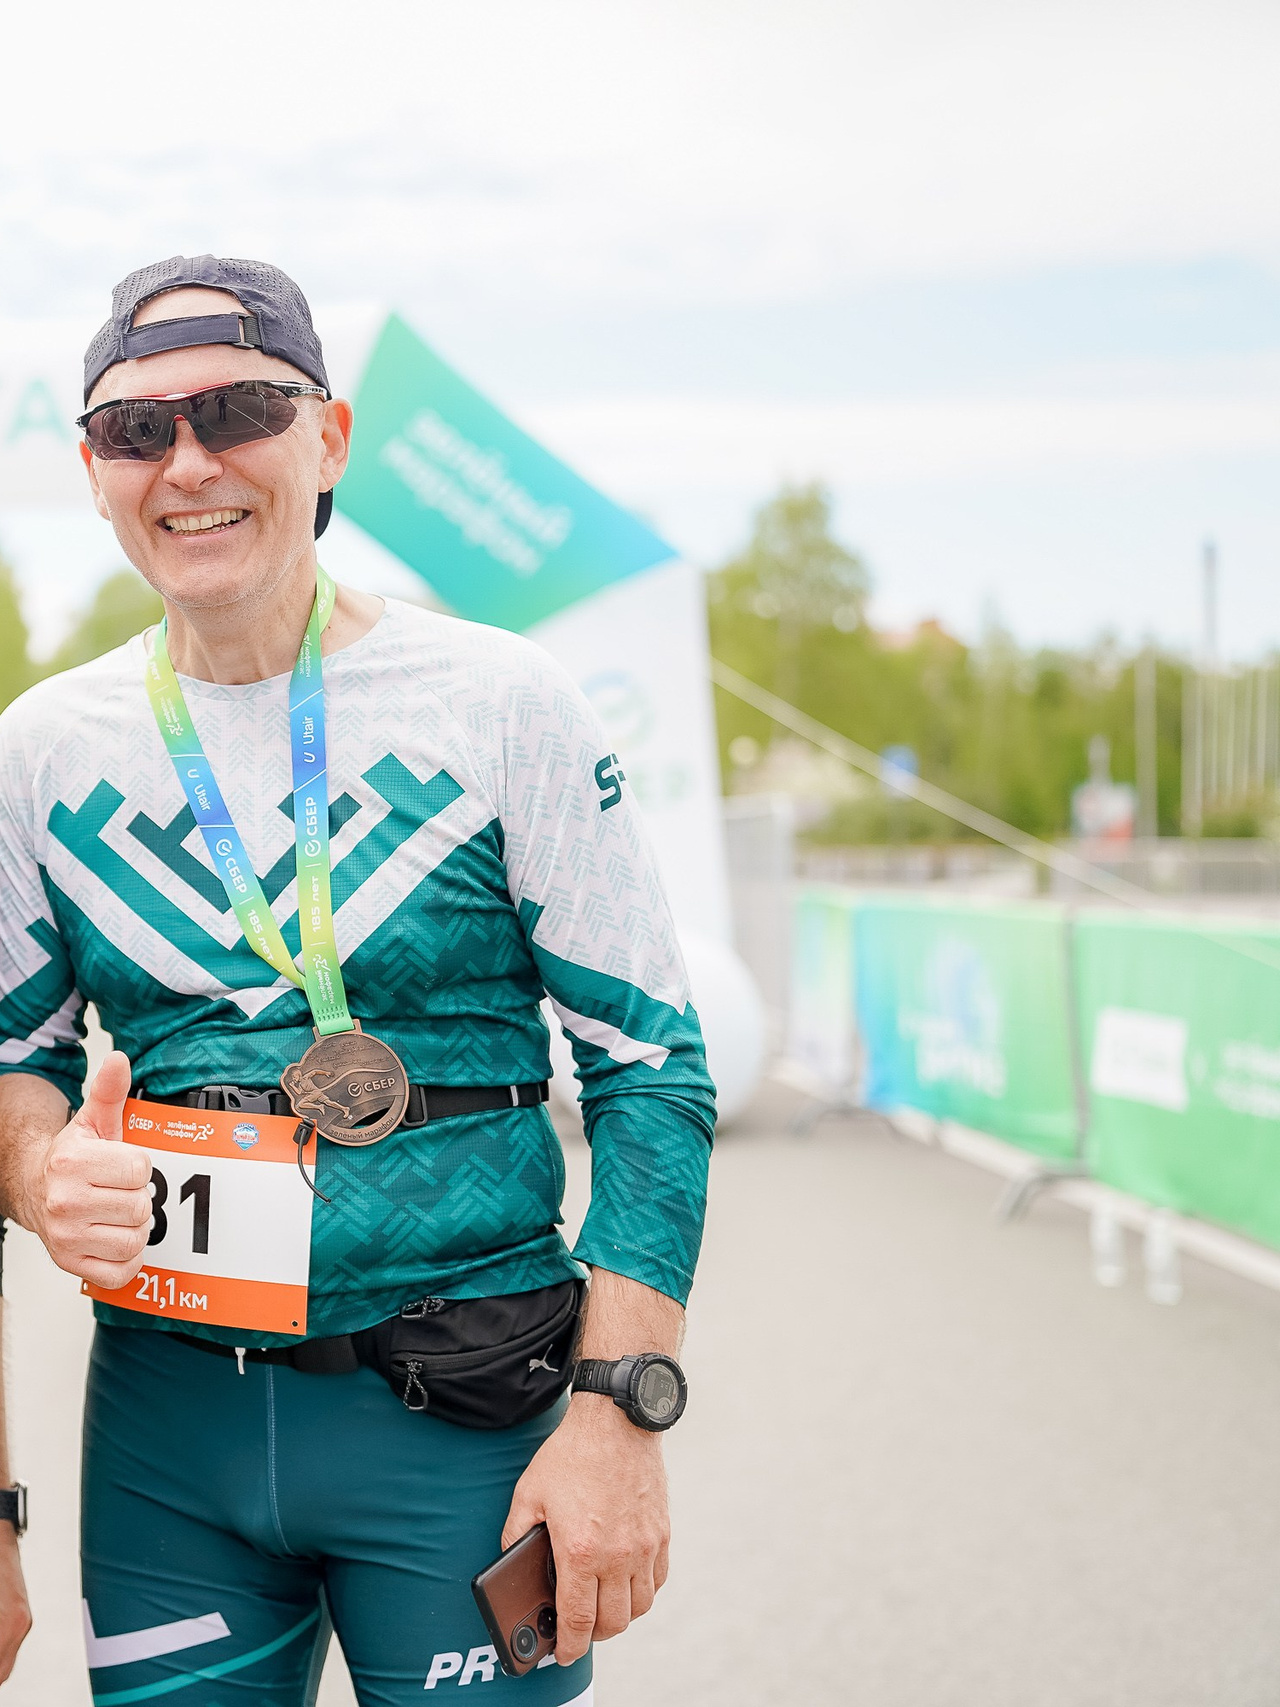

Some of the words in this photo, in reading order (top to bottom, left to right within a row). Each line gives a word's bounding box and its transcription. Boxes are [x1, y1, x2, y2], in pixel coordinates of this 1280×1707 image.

[302, 715, 315, 744] Utair
[193, 783, 211, 811] Utair
[305, 796, 318, 836] СБЕР
[225, 857, 248, 894] СБЕР
[311, 875, 320, 901] лет
[311, 905, 321, 933] 185
[247, 909, 264, 935] 185
[258, 936, 275, 961] лет
[363, 1077, 396, 1093] СБЕР
[135, 1117, 154, 1131] СБЕР
[163, 1128, 194, 1139] марафон
[166, 1120, 197, 1132] зелёный
[135, 1271, 176, 1310] 21,1
